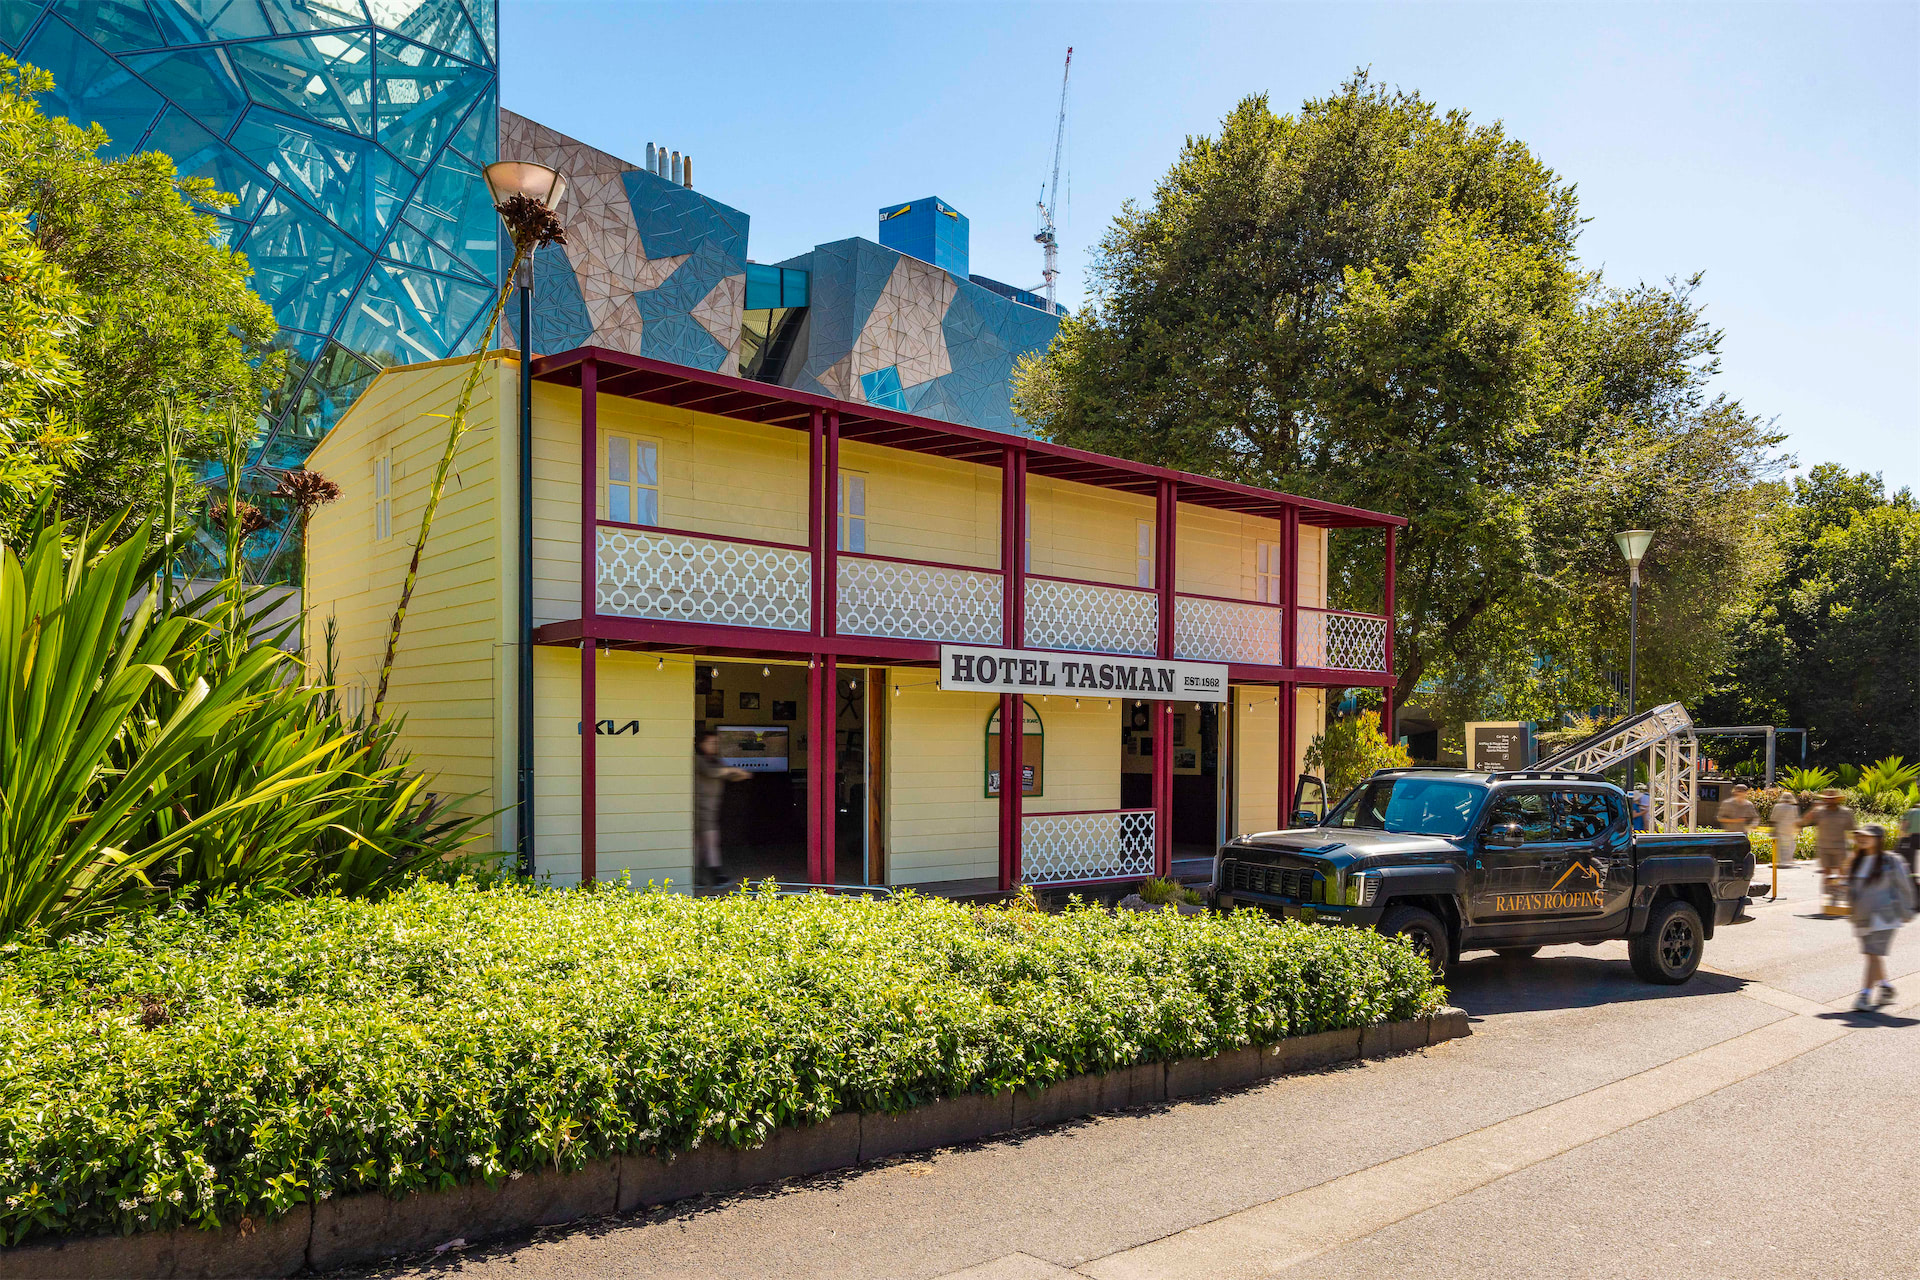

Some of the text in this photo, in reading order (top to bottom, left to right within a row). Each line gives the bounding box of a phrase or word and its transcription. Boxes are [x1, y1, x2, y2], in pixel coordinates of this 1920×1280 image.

[880, 212, 889, 221] EY
[951, 654, 1176, 692] HOTEL TASMAN
[1496, 891, 1604, 911] RAFA'S ROOFING
